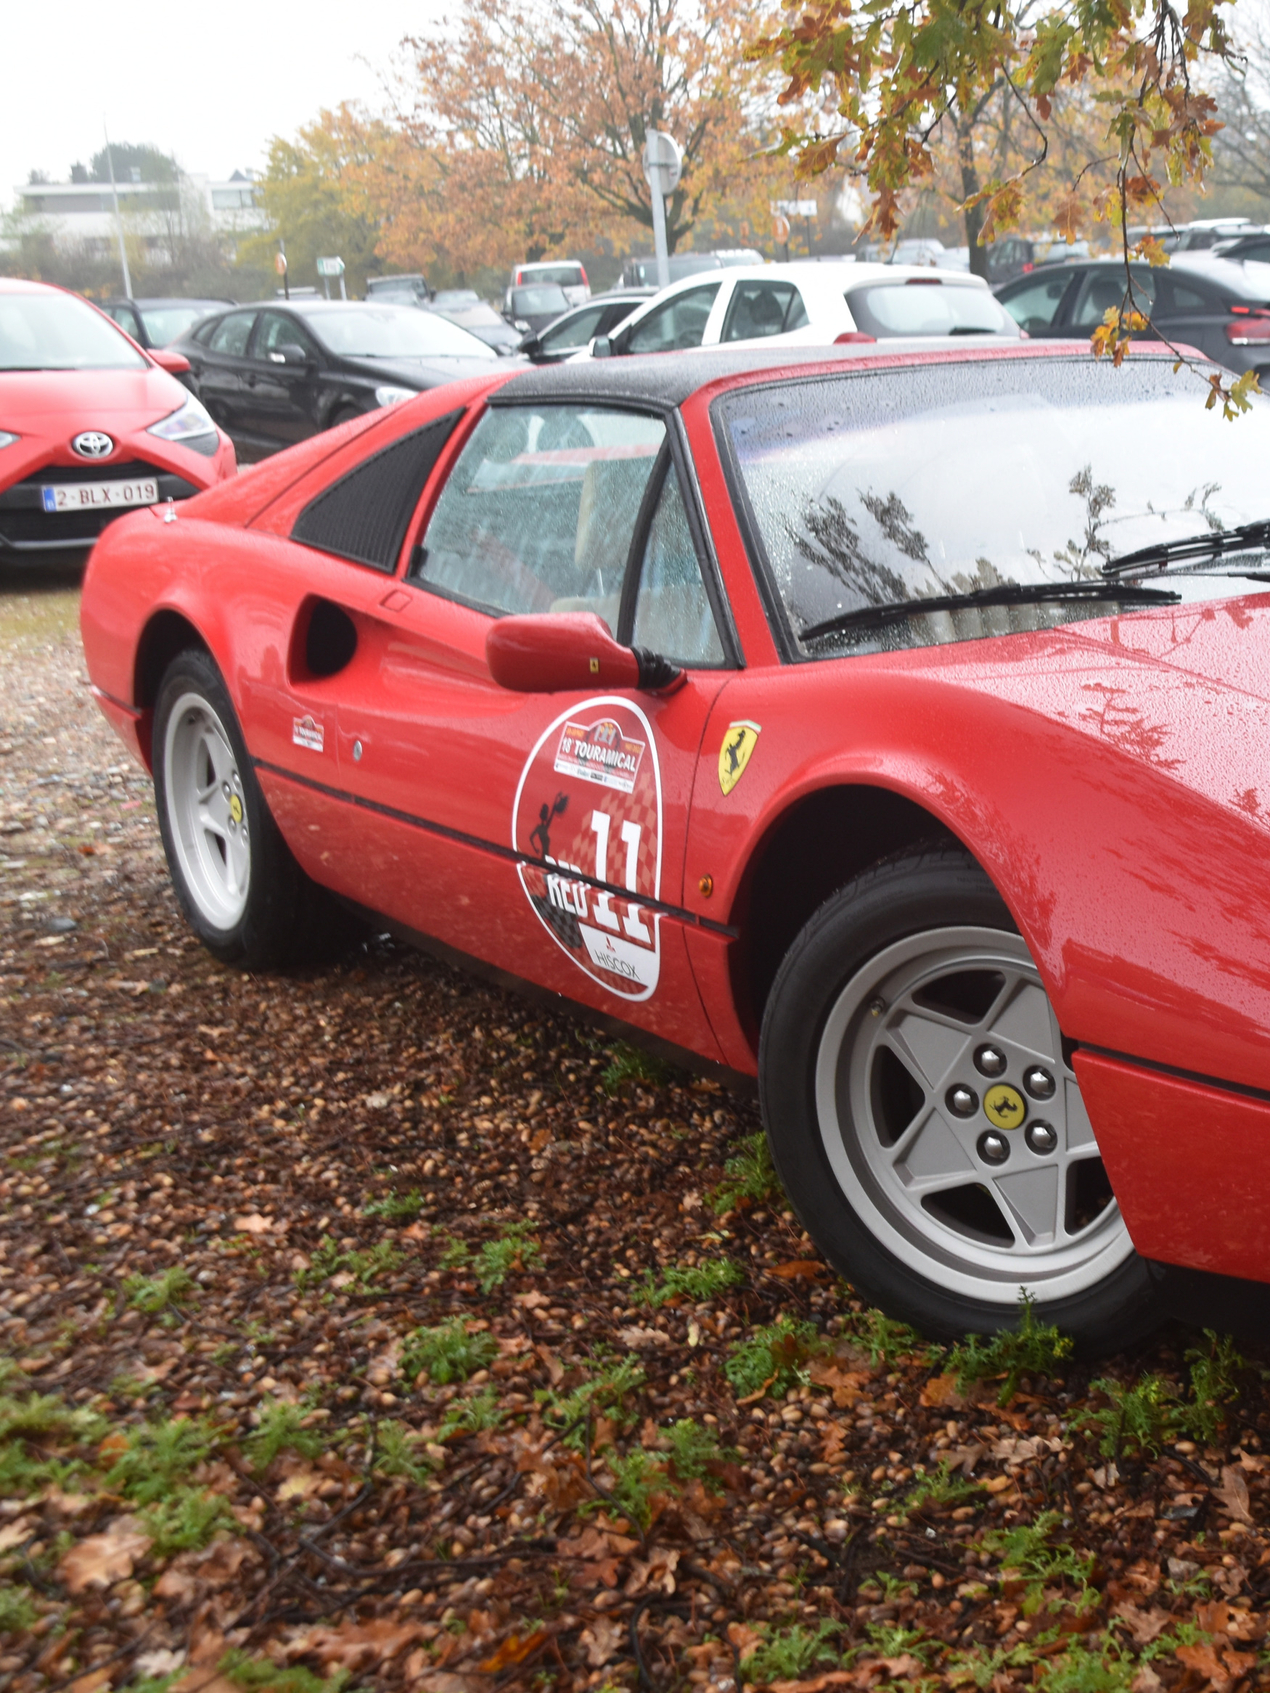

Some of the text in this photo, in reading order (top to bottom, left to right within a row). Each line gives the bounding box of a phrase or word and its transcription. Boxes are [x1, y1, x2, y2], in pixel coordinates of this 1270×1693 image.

[57, 483, 155, 507] 2-BLX-019
[575, 739, 636, 773] TOURAMICAL
[591, 810, 652, 945] 11
[594, 949, 641, 981] HISCOX
